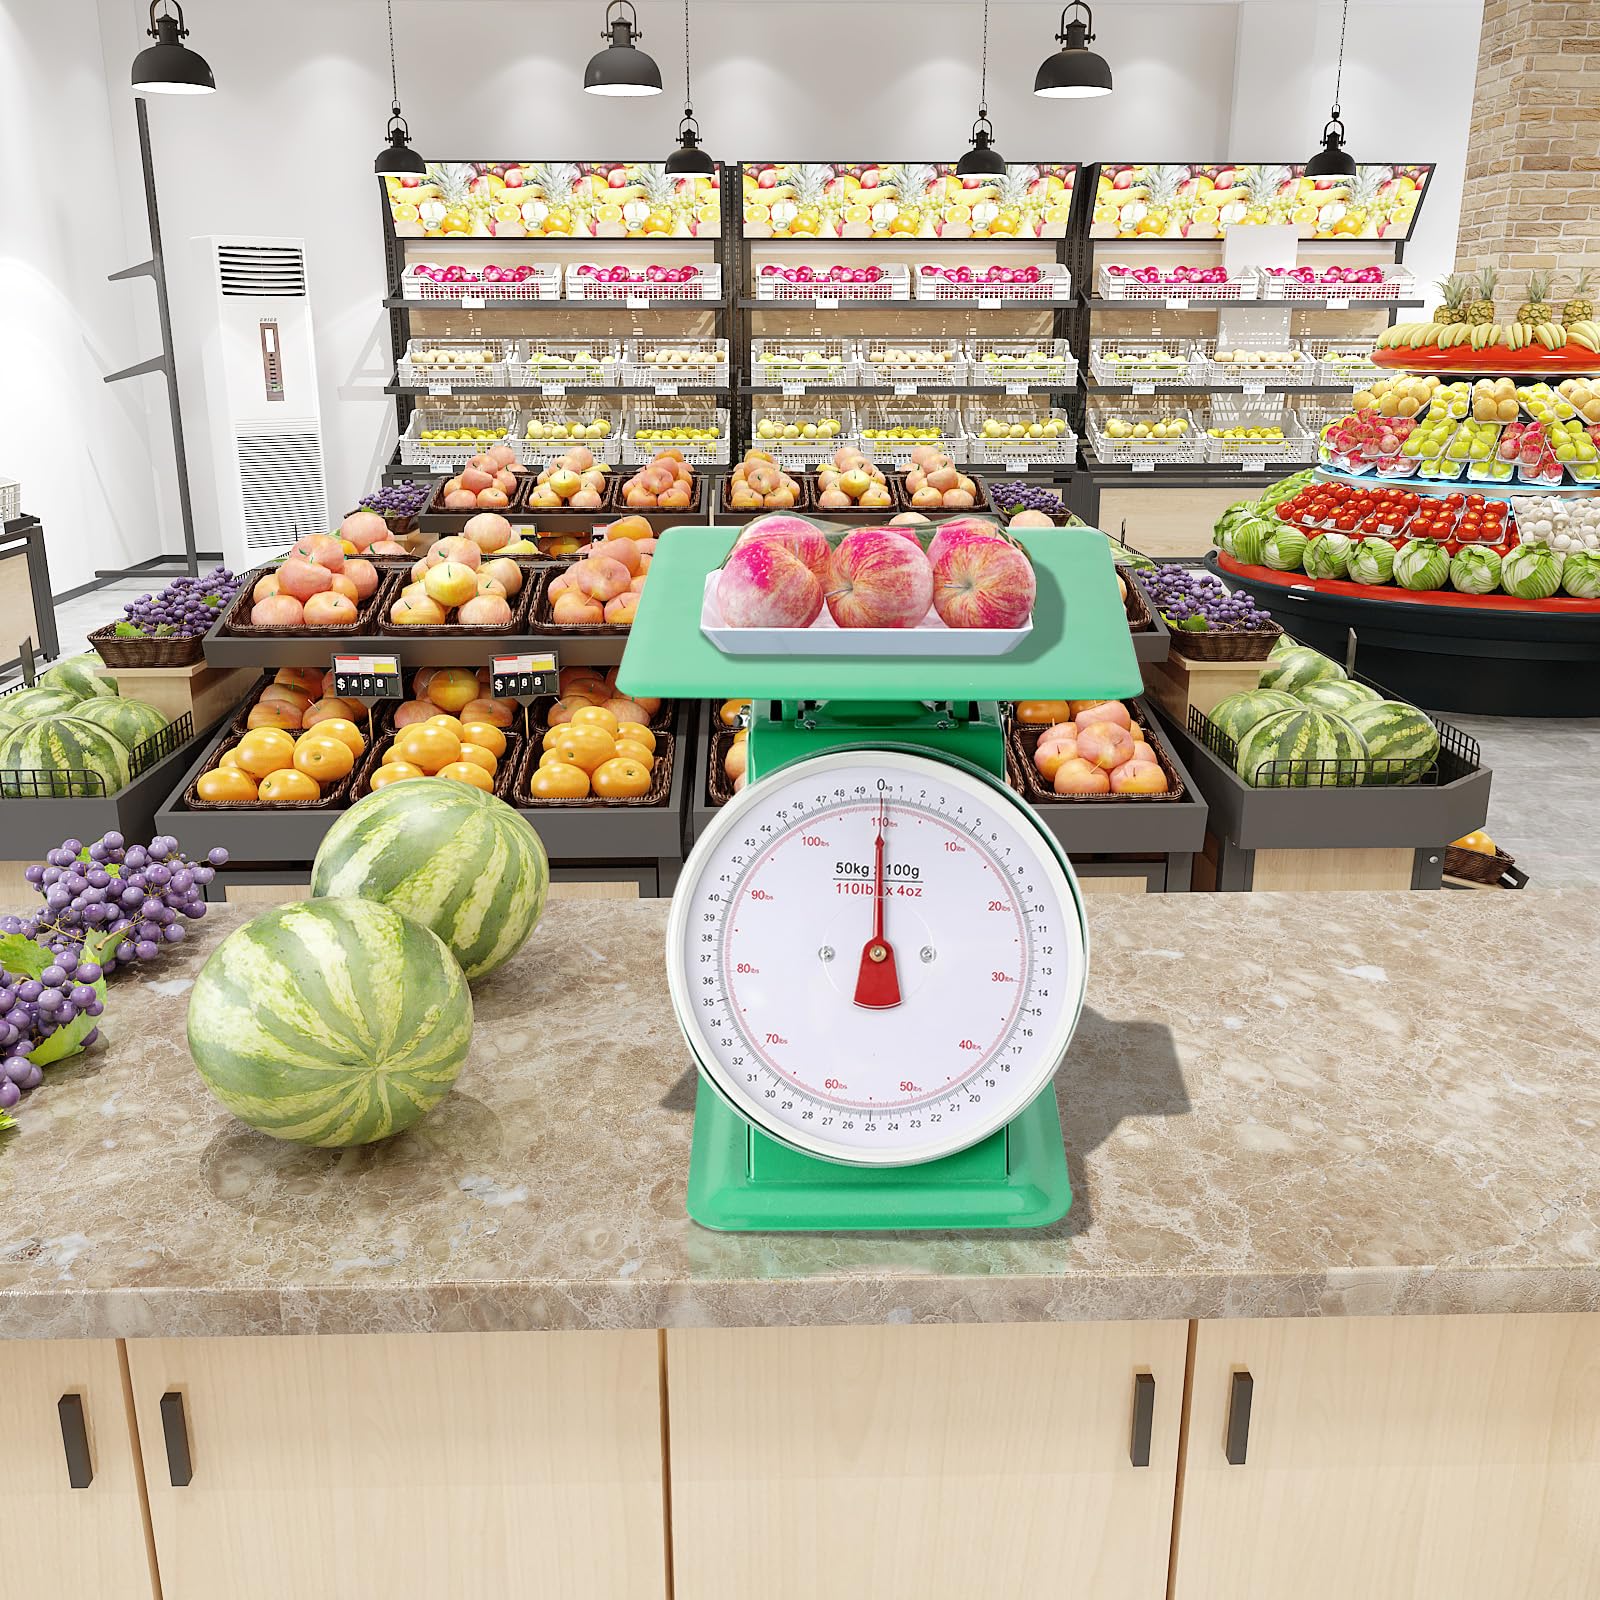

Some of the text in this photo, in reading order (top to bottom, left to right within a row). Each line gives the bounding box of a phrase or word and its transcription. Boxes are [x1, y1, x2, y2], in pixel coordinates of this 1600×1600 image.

[834, 789, 845, 797] 48
[854, 787, 866, 795] 49
[816, 796, 826, 804] 47
[732, 856, 742, 864] 42
[836, 862, 869, 876] 50kg
[886, 864, 919, 878] 100g
[836, 883, 873, 895] 110lb
[897, 885, 922, 897] 4oz
[702, 934, 712, 942] 38
[710, 1019, 721, 1027] 34
[747, 1074, 757, 1082] 31
[765, 1090, 776, 1098] 30
[950, 1104, 960, 1112] 21
[930, 1114, 941, 1122] 22
[910, 1120, 921, 1128] 23
